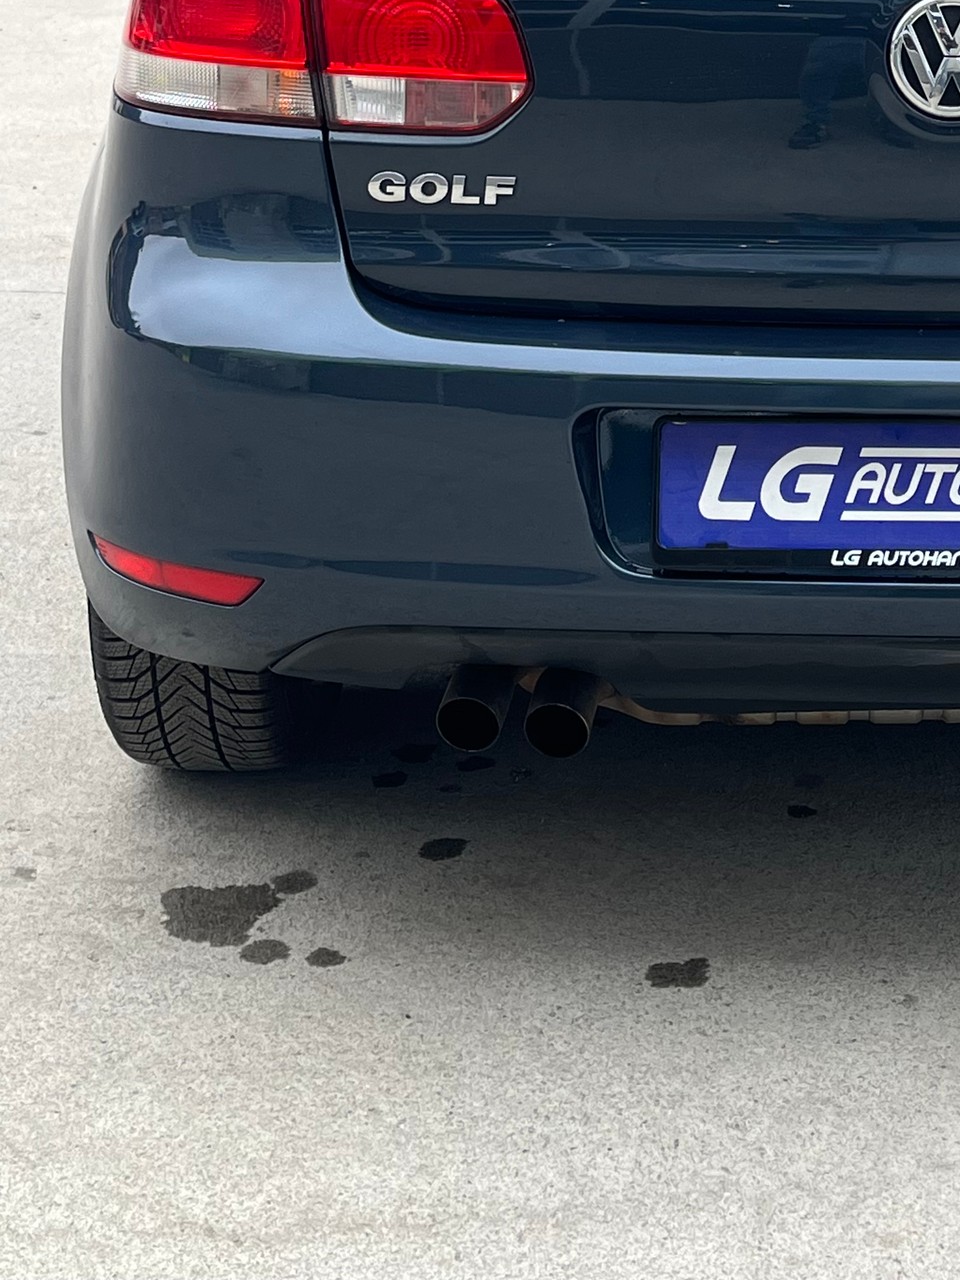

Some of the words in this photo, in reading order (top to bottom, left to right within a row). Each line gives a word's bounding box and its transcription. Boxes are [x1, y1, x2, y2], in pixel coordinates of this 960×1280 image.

[368, 171, 516, 205] GOLF
[698, 445, 843, 522] LG
[830, 549, 862, 566] LG
